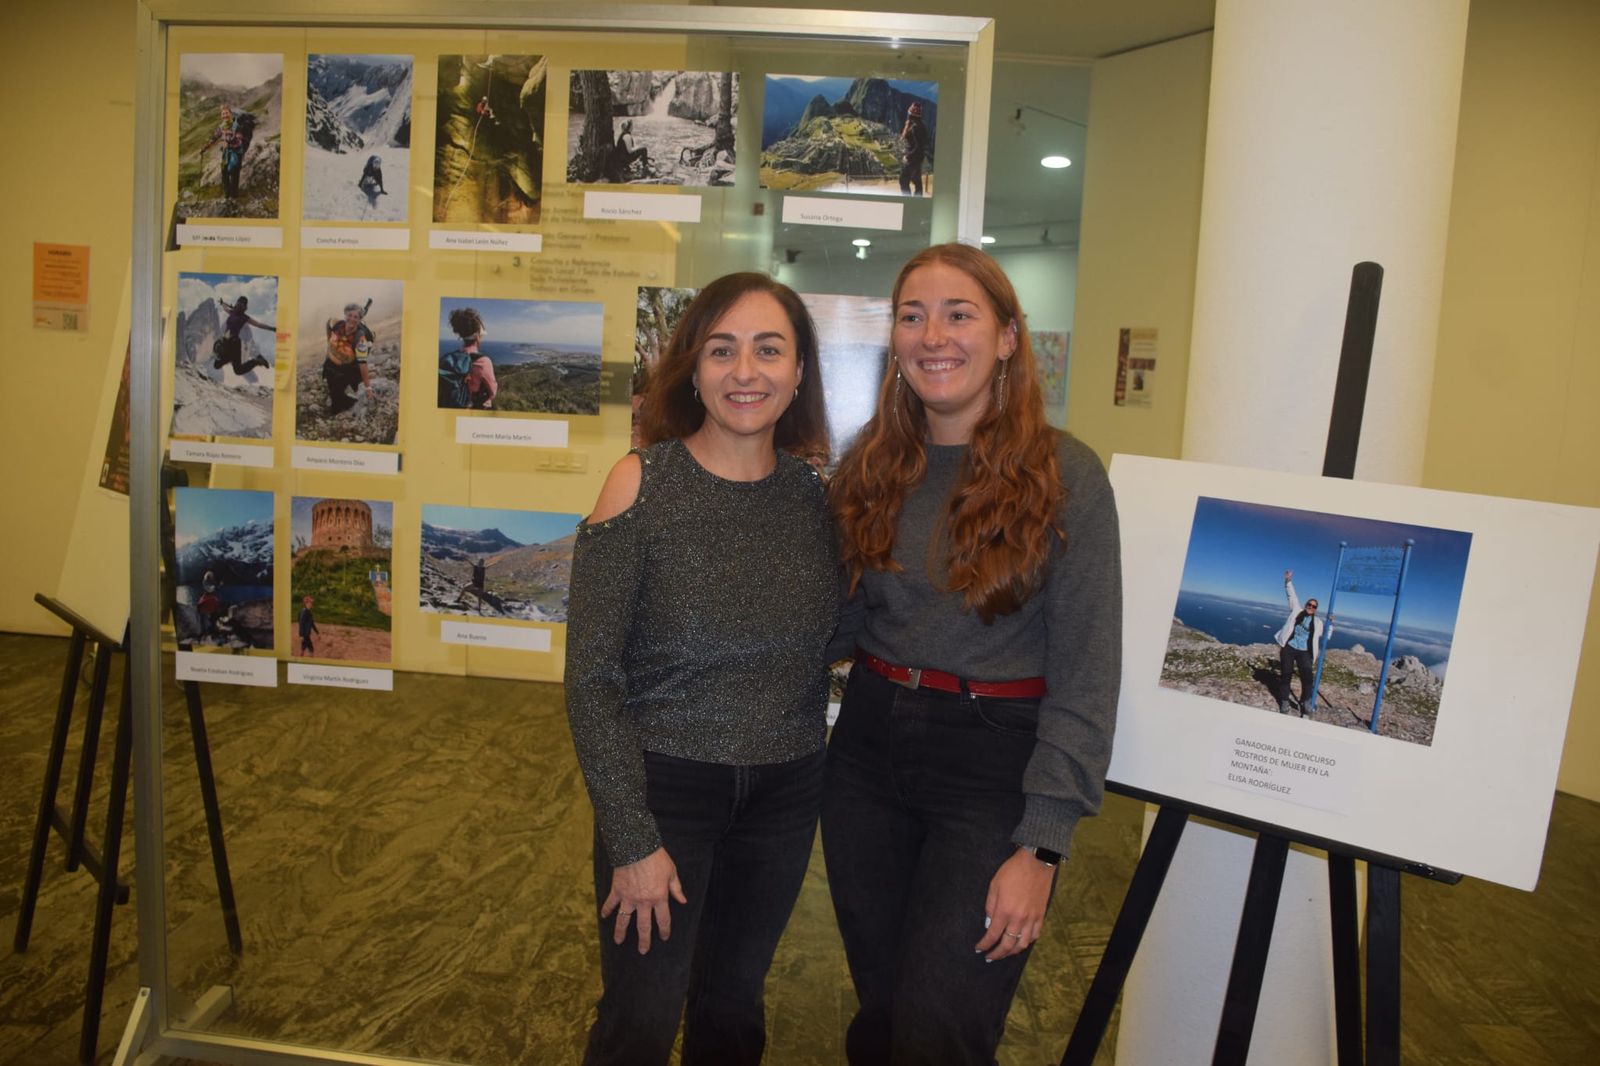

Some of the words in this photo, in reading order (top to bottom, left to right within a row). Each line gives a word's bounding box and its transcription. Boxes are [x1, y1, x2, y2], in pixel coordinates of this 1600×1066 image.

[619, 207, 642, 215] Sánchez
[800, 213, 821, 221] Susana
[822, 214, 843, 223] Ortega
[513, 256, 522, 268] 3
[469, 633, 487, 641] Bueno
[1235, 737, 1277, 753] GANADORA
[1278, 747, 1291, 757] DEL
[1293, 751, 1336, 767] CONCURSO
[1269, 758, 1279, 766] DE
[1280, 760, 1309, 772] MUJER
[1307, 766, 1318, 775] EN
[1319, 768, 1329, 777] LA
[1228, 773, 1247, 784] ELISA
[1248, 777, 1291, 794] RODRÍGUEZ
